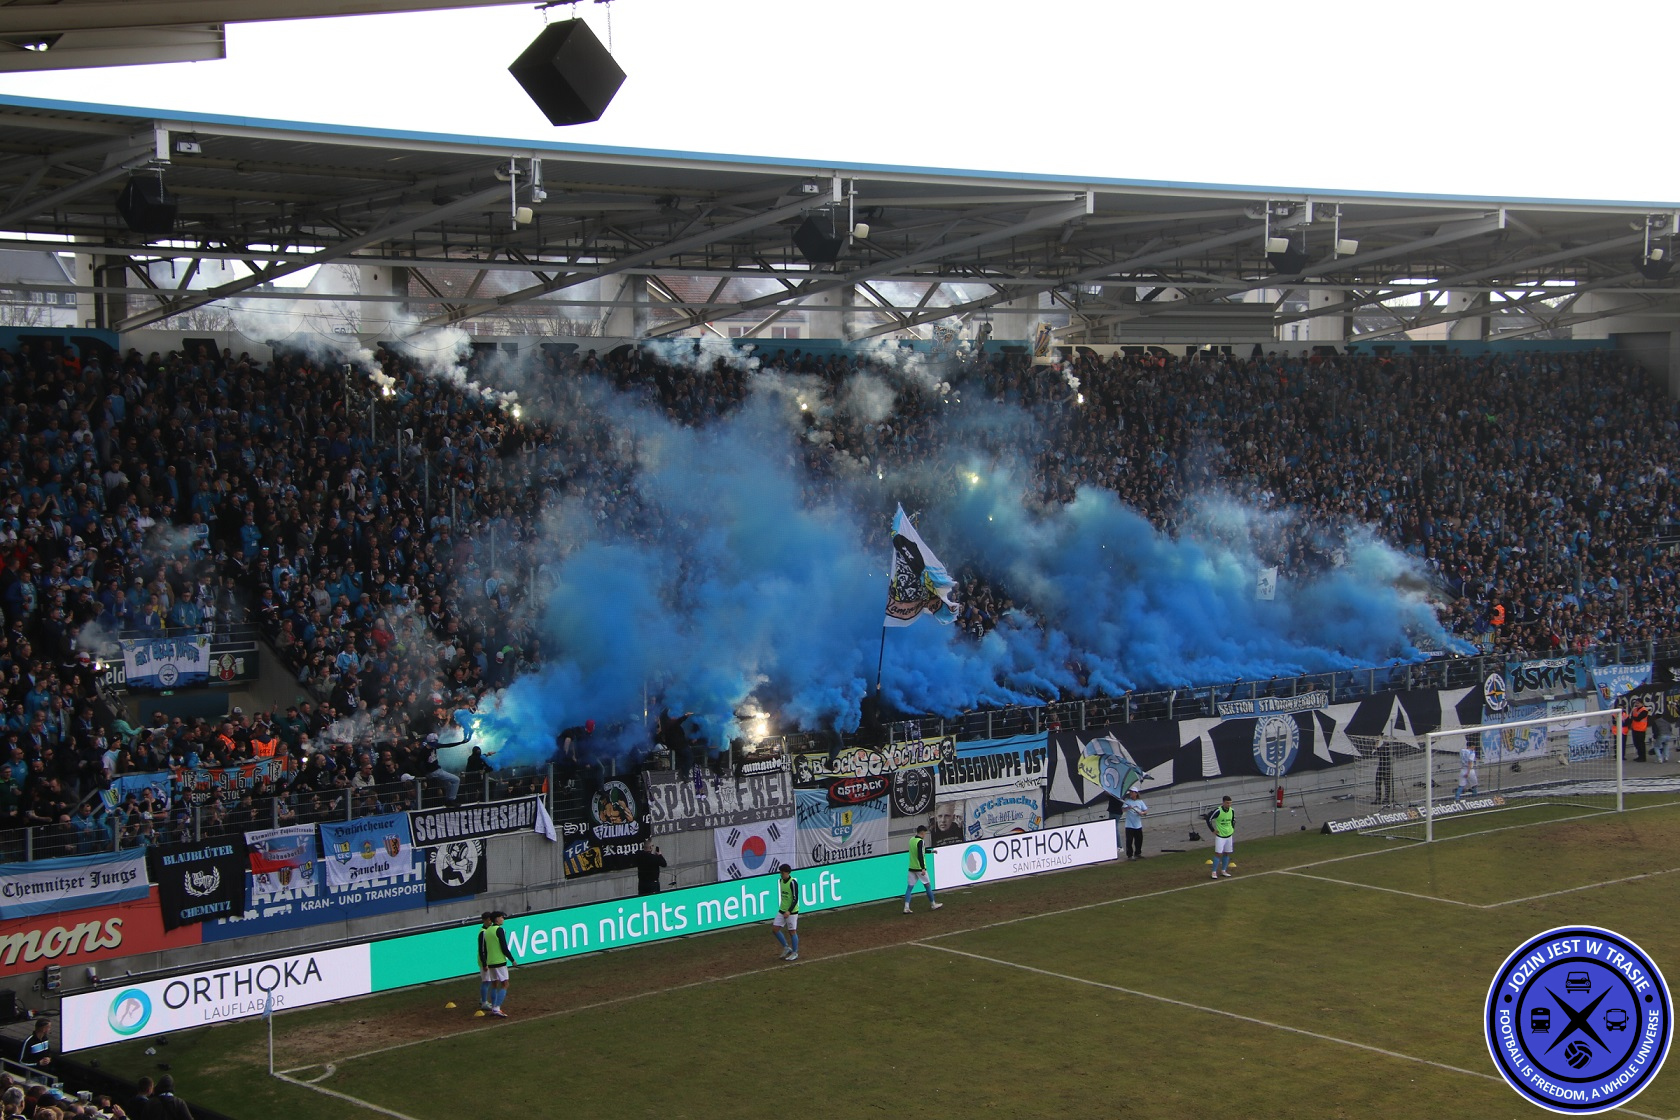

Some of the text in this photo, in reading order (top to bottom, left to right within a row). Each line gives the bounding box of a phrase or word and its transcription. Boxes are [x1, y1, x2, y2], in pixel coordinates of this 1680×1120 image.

[105, 665, 126, 684] eld
[1218, 701, 1255, 716] SEKTION
[1024, 747, 1047, 775] OST
[1265, 766, 1286, 777] 199
[1418, 795, 1506, 818] Eenbach Tresore.de
[414, 800, 537, 842] SCHWEIKERSHAI
[833, 826, 851, 836] CFC
[1328, 808, 1418, 833] Eisenbach Tresore.de
[565, 840, 590, 858] FCK
[812, 838, 873, 865] Chemnitz
[993, 828, 1089, 863] ORTHOKA
[349, 861, 390, 880] Fanclub
[1012, 854, 1073, 874] SANITÄTSHAUS
[2, 867, 137, 898] Chemnitzer Jungs
[180, 901, 232, 919] CHEMNITZ
[301, 883, 427, 912] KRAN- UND TRANSPORT
[507, 870, 842, 957] Wenn nichts mehr luft
[163, 957, 323, 1010] ORTHOKA
[204, 995, 285, 1021] LAUFLABOR
